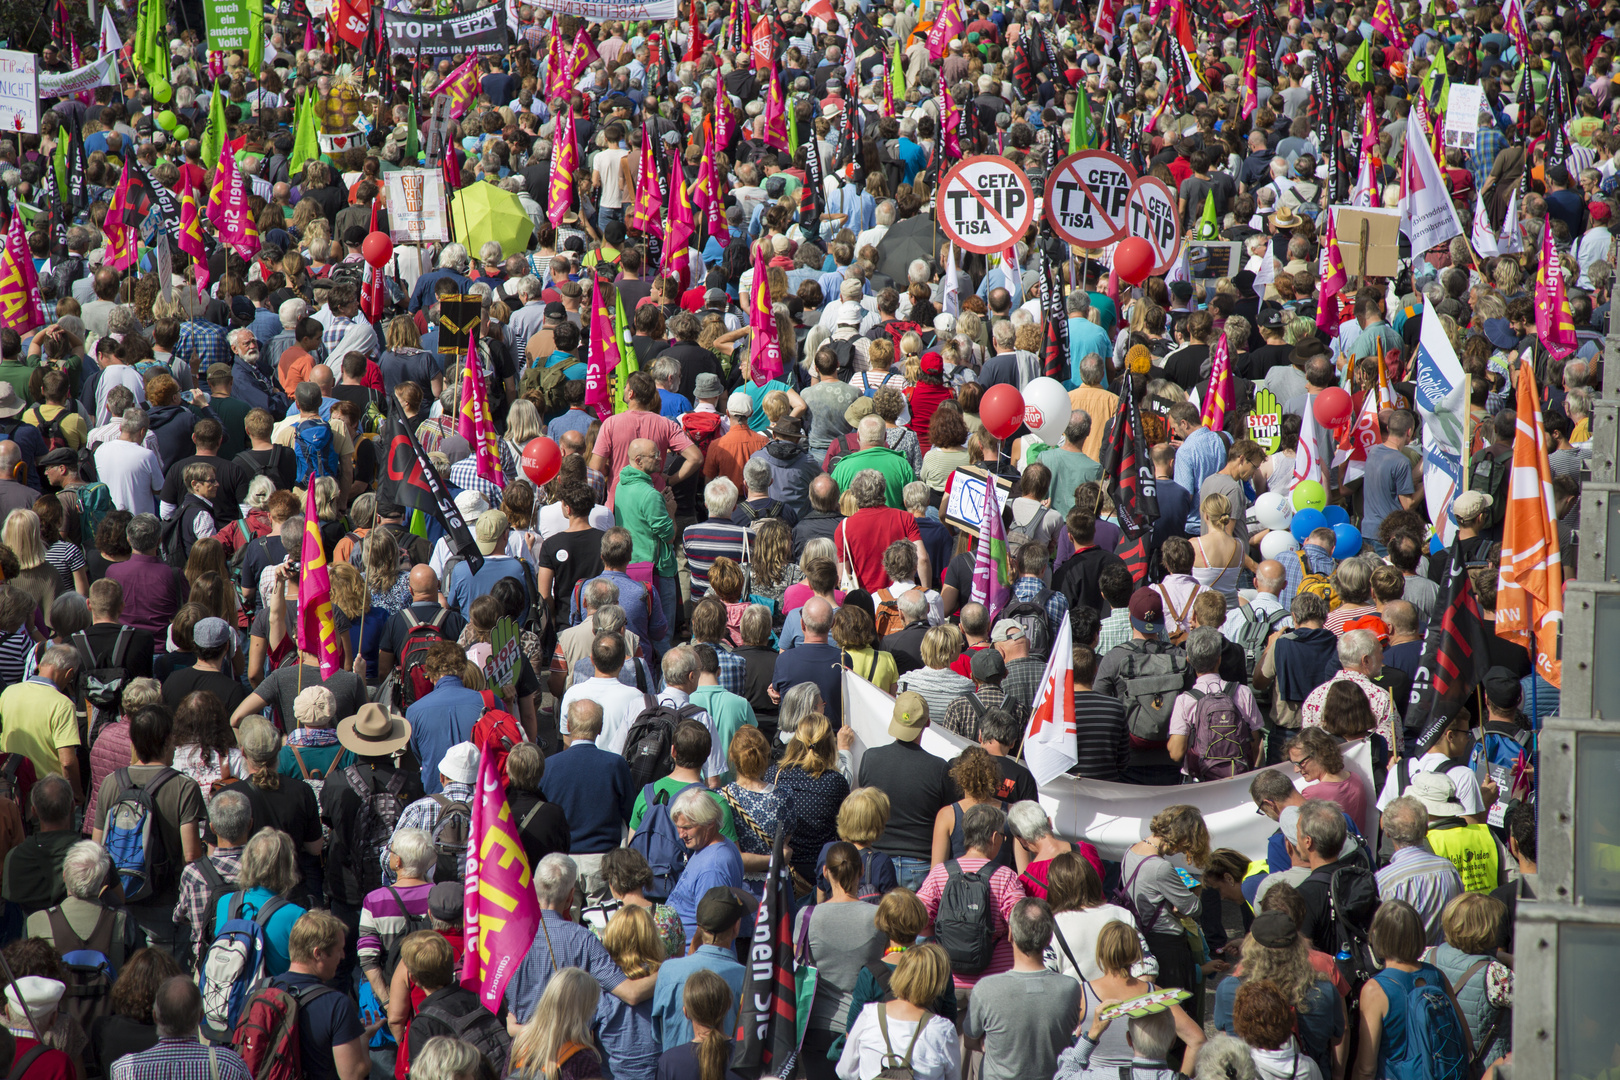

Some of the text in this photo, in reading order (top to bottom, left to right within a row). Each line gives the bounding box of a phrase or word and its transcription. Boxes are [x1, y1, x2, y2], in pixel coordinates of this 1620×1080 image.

[215, 3, 239, 14] euch
[220, 15, 236, 25] ein
[459, 16, 492, 35] EPA
[210, 27, 249, 37] anderes
[385, 21, 442, 39] STOP!
[218, 38, 242, 49] Volk!
[451, 46, 462, 54] IN
[403, 176, 423, 189] STOP
[977, 173, 1019, 189] CETA
[1088, 169, 1129, 187] CETA
[405, 188, 422, 199] CETA
[1056, 181, 1130, 218] TTIP
[407, 200, 422, 210] TTIP
[947, 187, 1025, 221] TTIP
[1149, 196, 1173, 220] CETA
[955, 221, 992, 235] TiSA
[1060, 212, 1095, 230] TiSA
[1131, 201, 1176, 250] TTIP
[586, 363, 601, 391] Sie
[1248, 414, 1277, 427] STOP
[1253, 425, 1281, 438] TTIP!
[437, 497, 462, 529] Sie
[487, 639, 515, 677] STOP
[493, 645, 521, 683] TTIP!
[1474, 850, 1490, 860] laden
